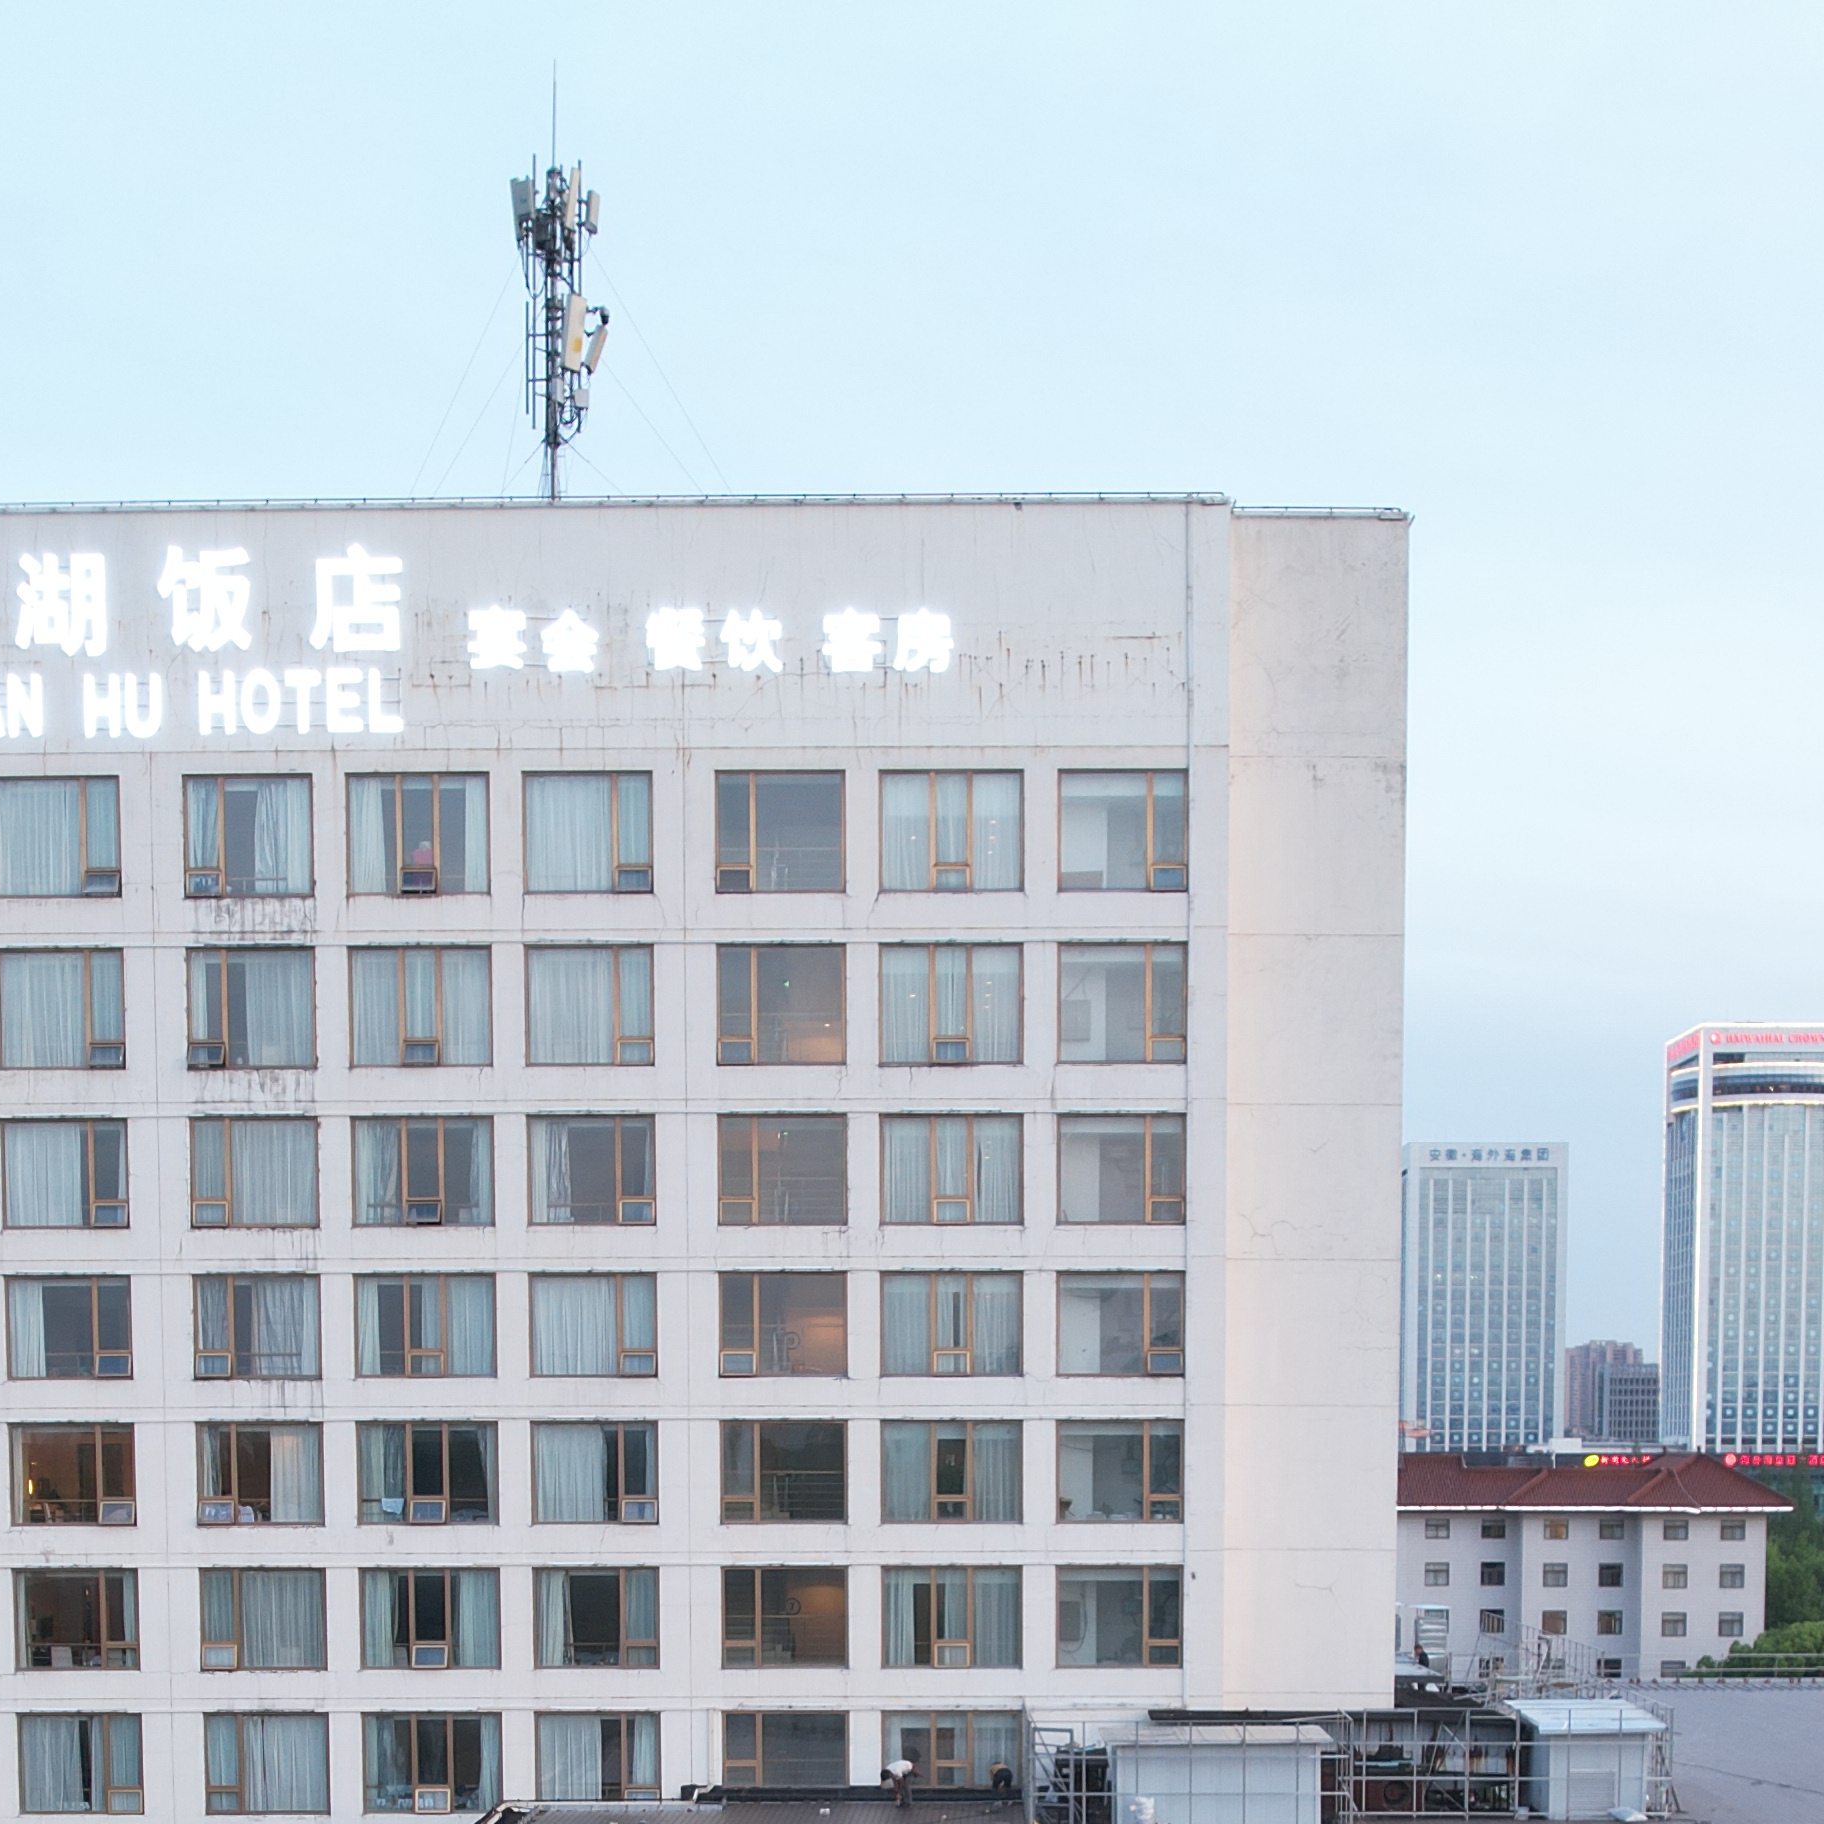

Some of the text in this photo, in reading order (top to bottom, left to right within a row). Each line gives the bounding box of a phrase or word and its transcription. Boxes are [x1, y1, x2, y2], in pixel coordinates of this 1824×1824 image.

[822, 607, 956, 673] 客房
[83, 672, 165, 740] HU
[198, 667, 405, 737] HOTEL
